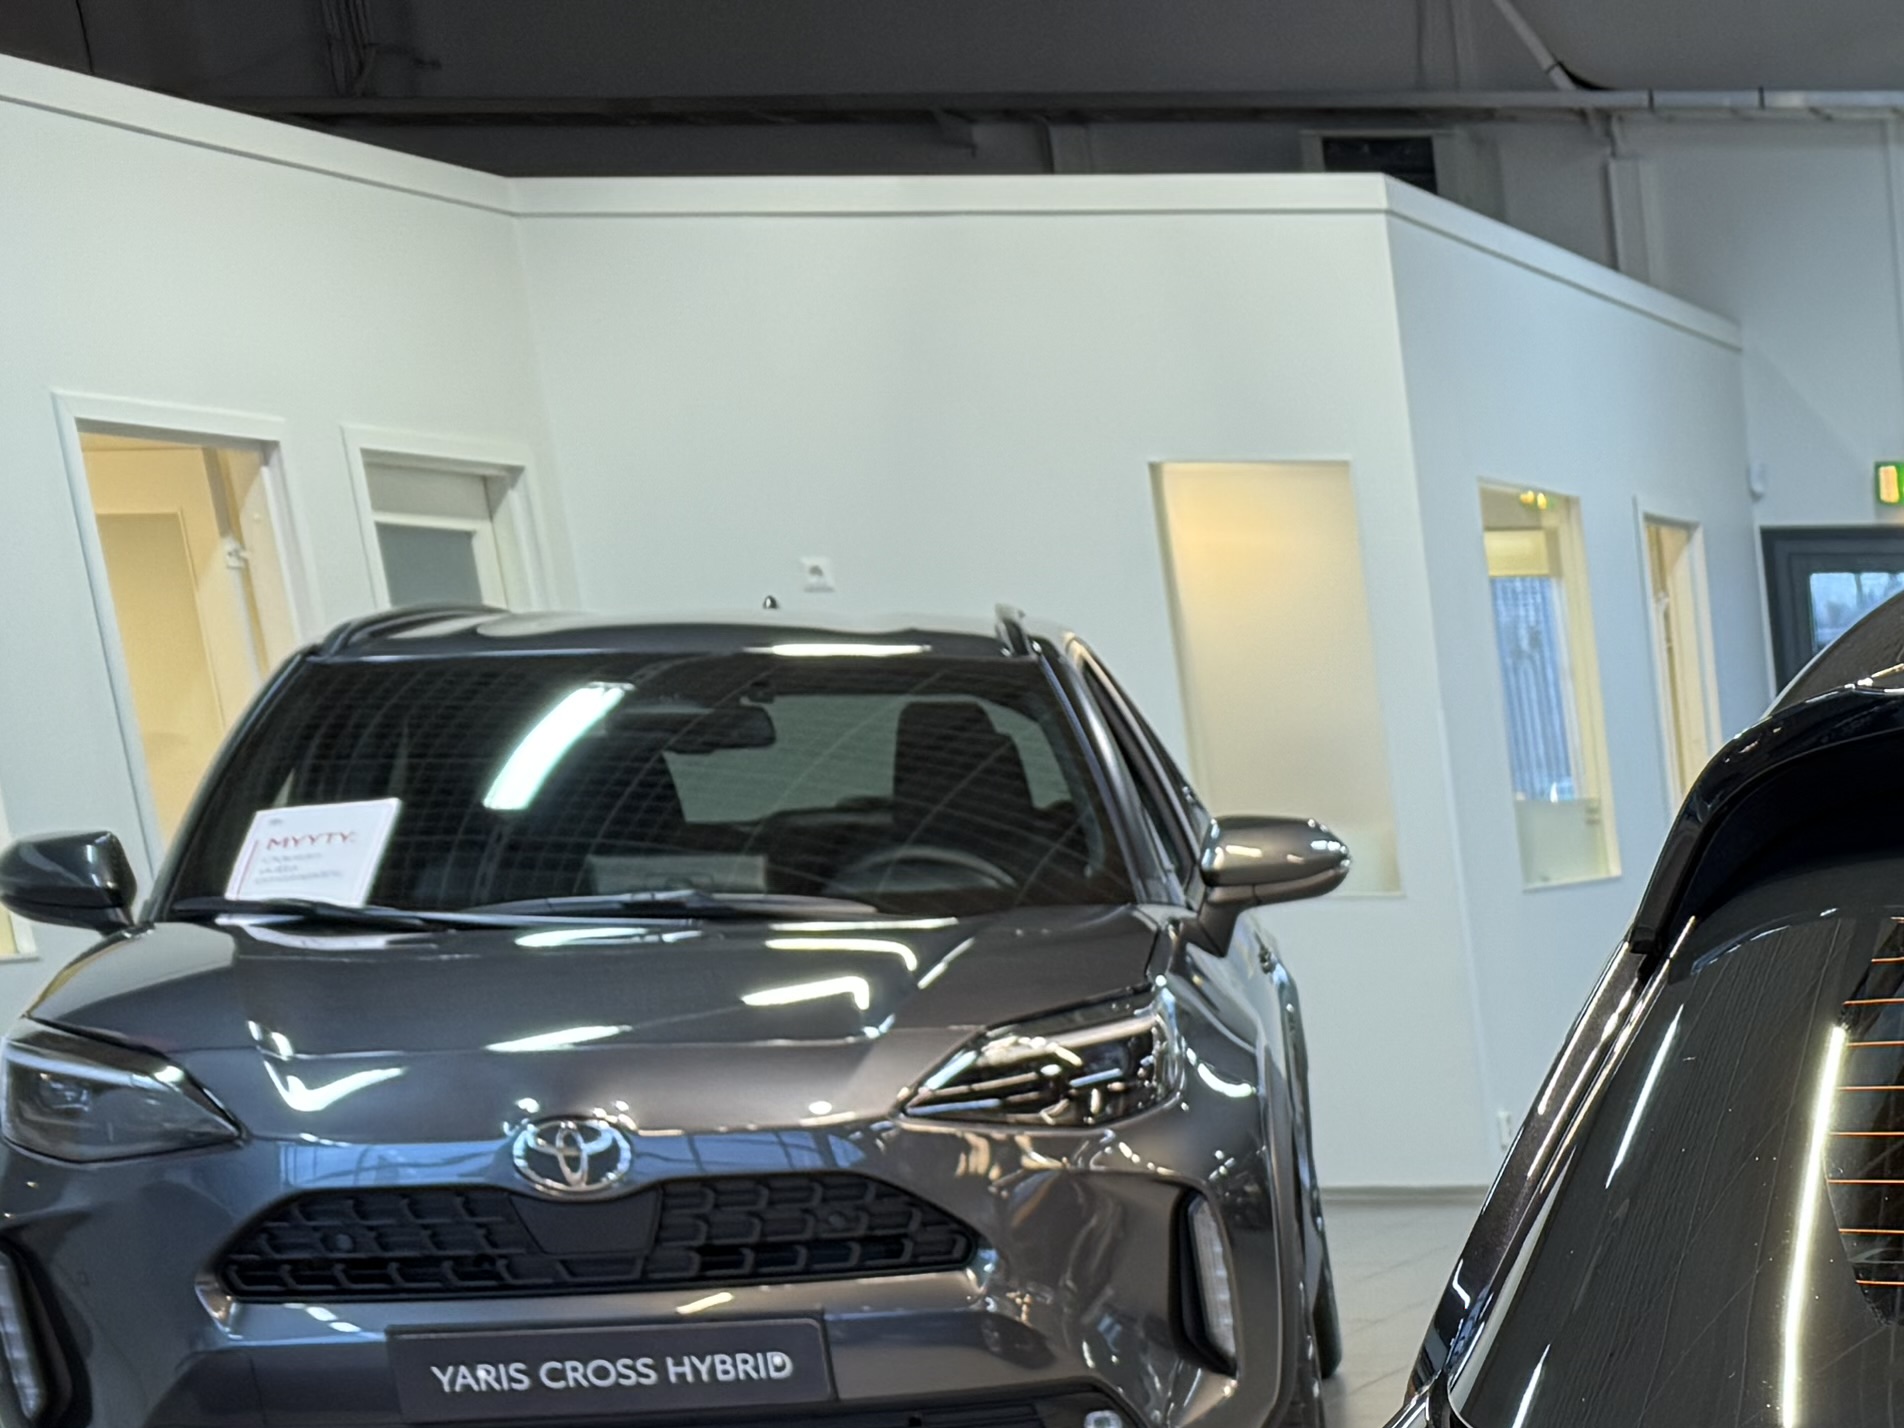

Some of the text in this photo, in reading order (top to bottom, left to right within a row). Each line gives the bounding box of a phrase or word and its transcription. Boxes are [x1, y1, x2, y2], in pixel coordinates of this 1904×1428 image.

[430, 1350, 794, 1393] YARIS CROSS HYBRID
